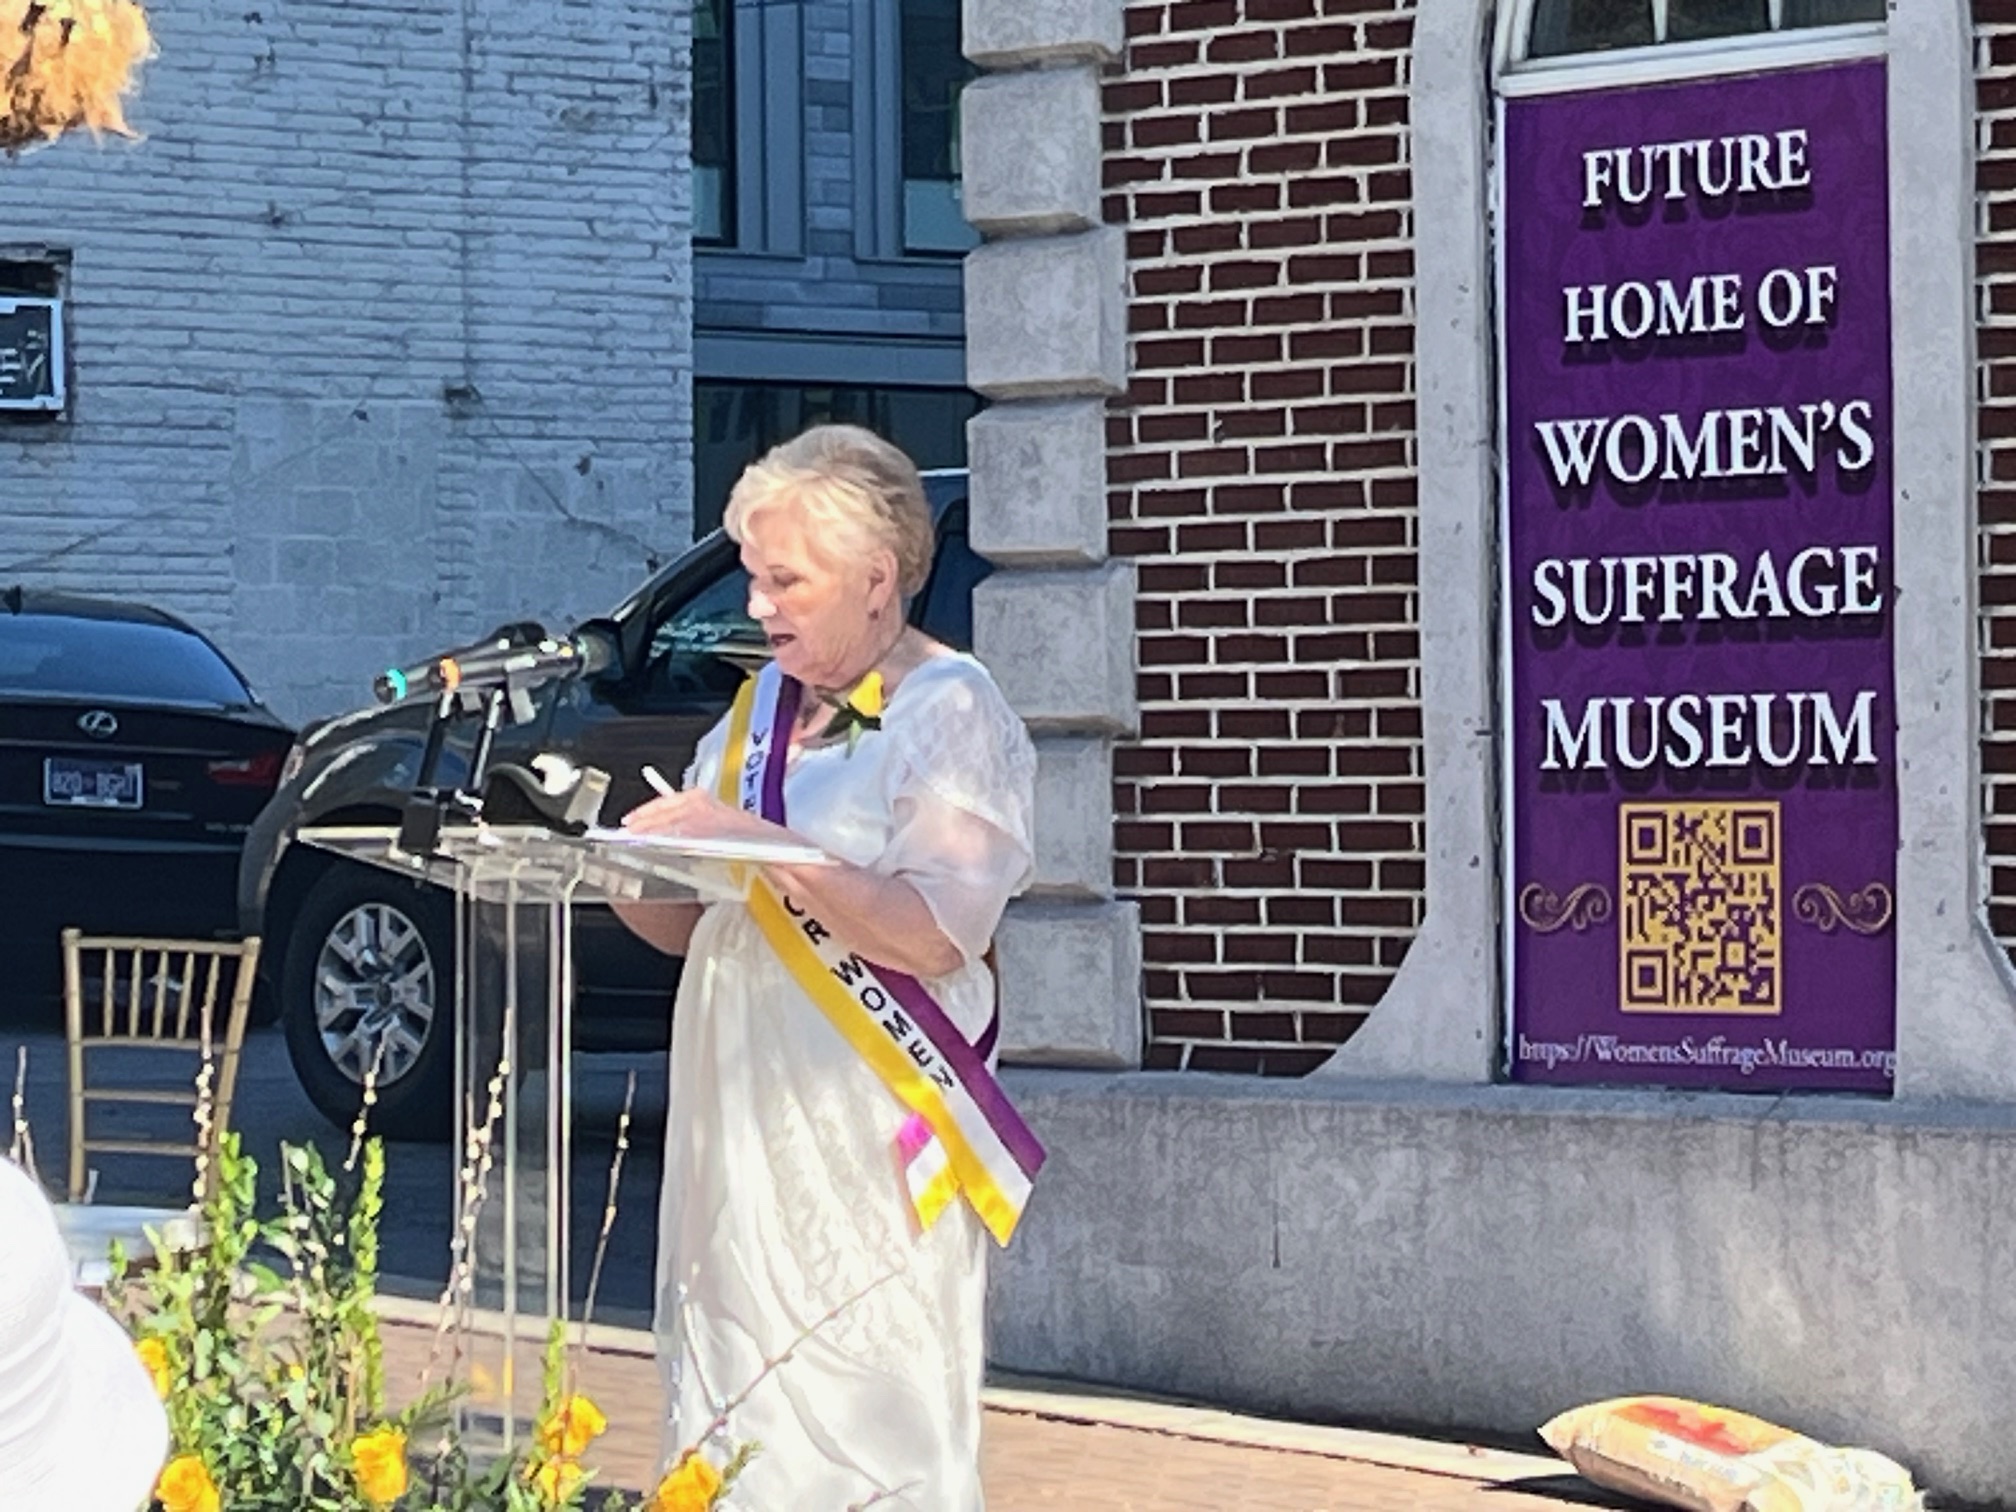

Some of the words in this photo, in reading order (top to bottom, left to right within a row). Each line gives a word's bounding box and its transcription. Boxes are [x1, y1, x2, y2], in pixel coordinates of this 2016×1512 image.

[1582, 129, 1810, 206] FUTURE
[1563, 275, 1744, 342] HOME
[1759, 266, 1837, 326] OF
[1535, 400, 1873, 486] WOMEN'S
[1532, 546, 1882, 626] SUFFRAGE
[1540, 691, 1877, 769] MUSEUM
[829, 951, 955, 1091] WOMEN
